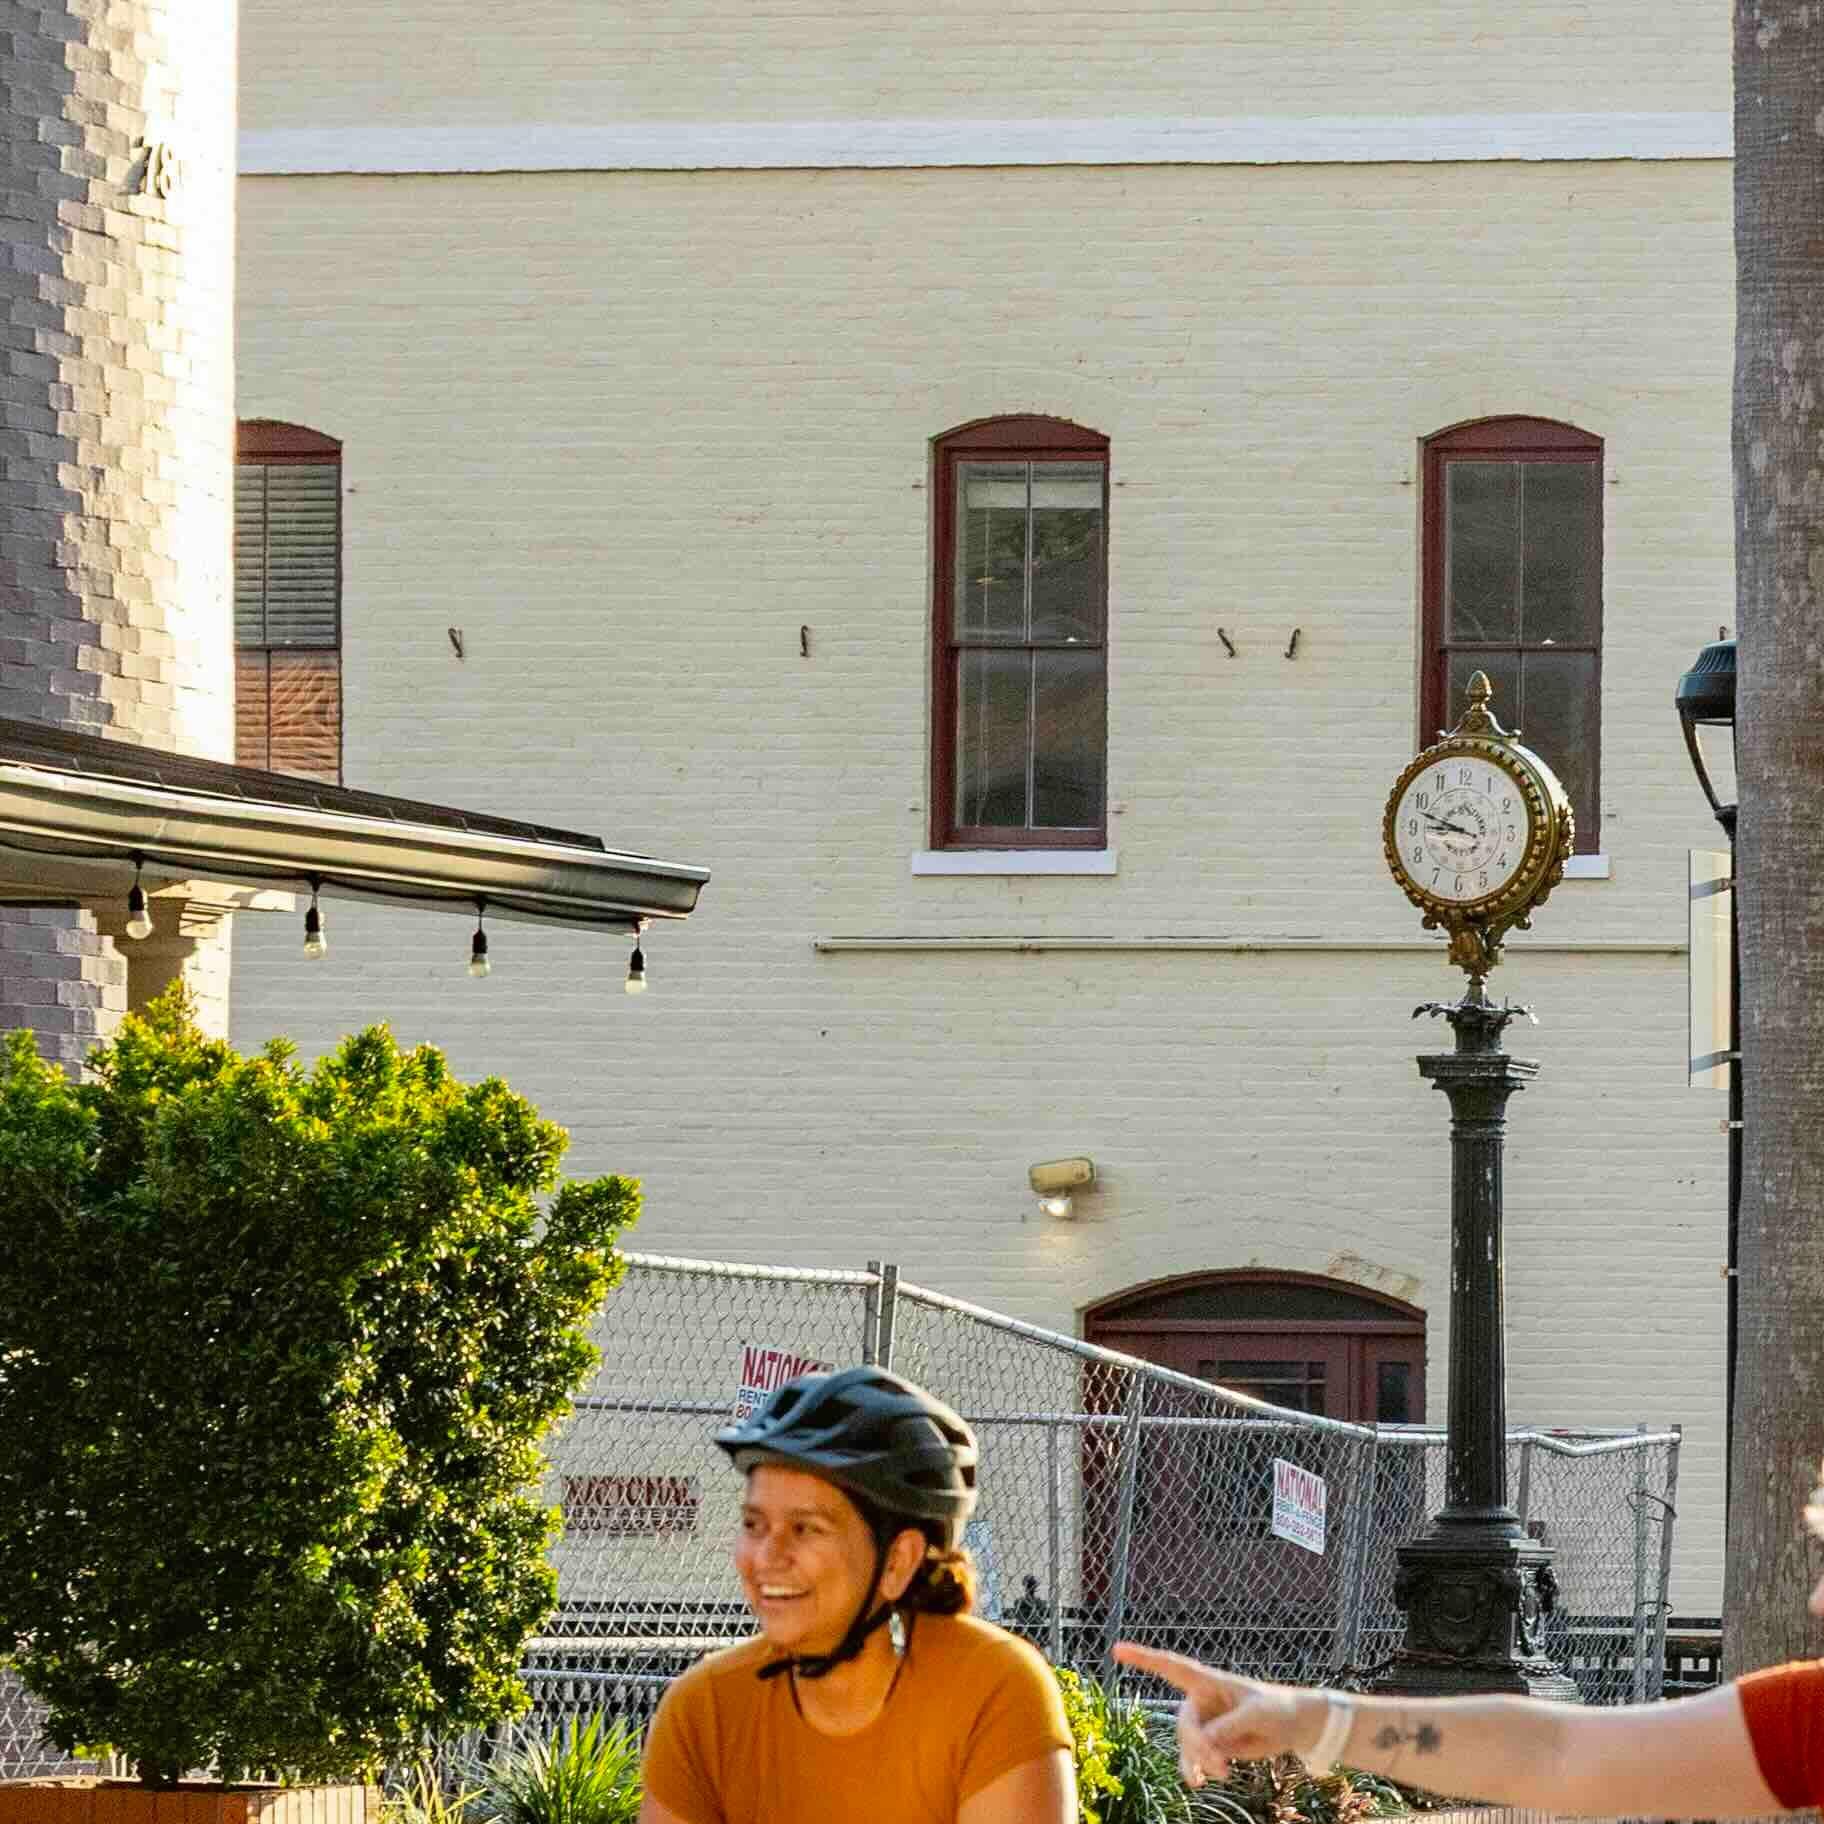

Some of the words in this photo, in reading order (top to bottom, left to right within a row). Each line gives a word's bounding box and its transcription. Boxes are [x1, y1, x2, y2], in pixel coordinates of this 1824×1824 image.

[1436, 774, 1446, 792] 11
[1459, 767, 1473, 786] 12
[1487, 777, 1492, 793] 1
[1415, 792, 1429, 810] 10
[1502, 798, 1511, 815] 2
[1409, 818, 1418, 837] 9
[1506, 824, 1516, 842] 3
[1413, 846, 1423, 864] 8
[1497, 852, 1507, 869] 4
[1432, 867, 1441, 885] 7
[1454, 875, 1463, 892] 6
[1479, 872, 1488, 889] 5
[1276, 1462, 1323, 1513] NATIONAL
